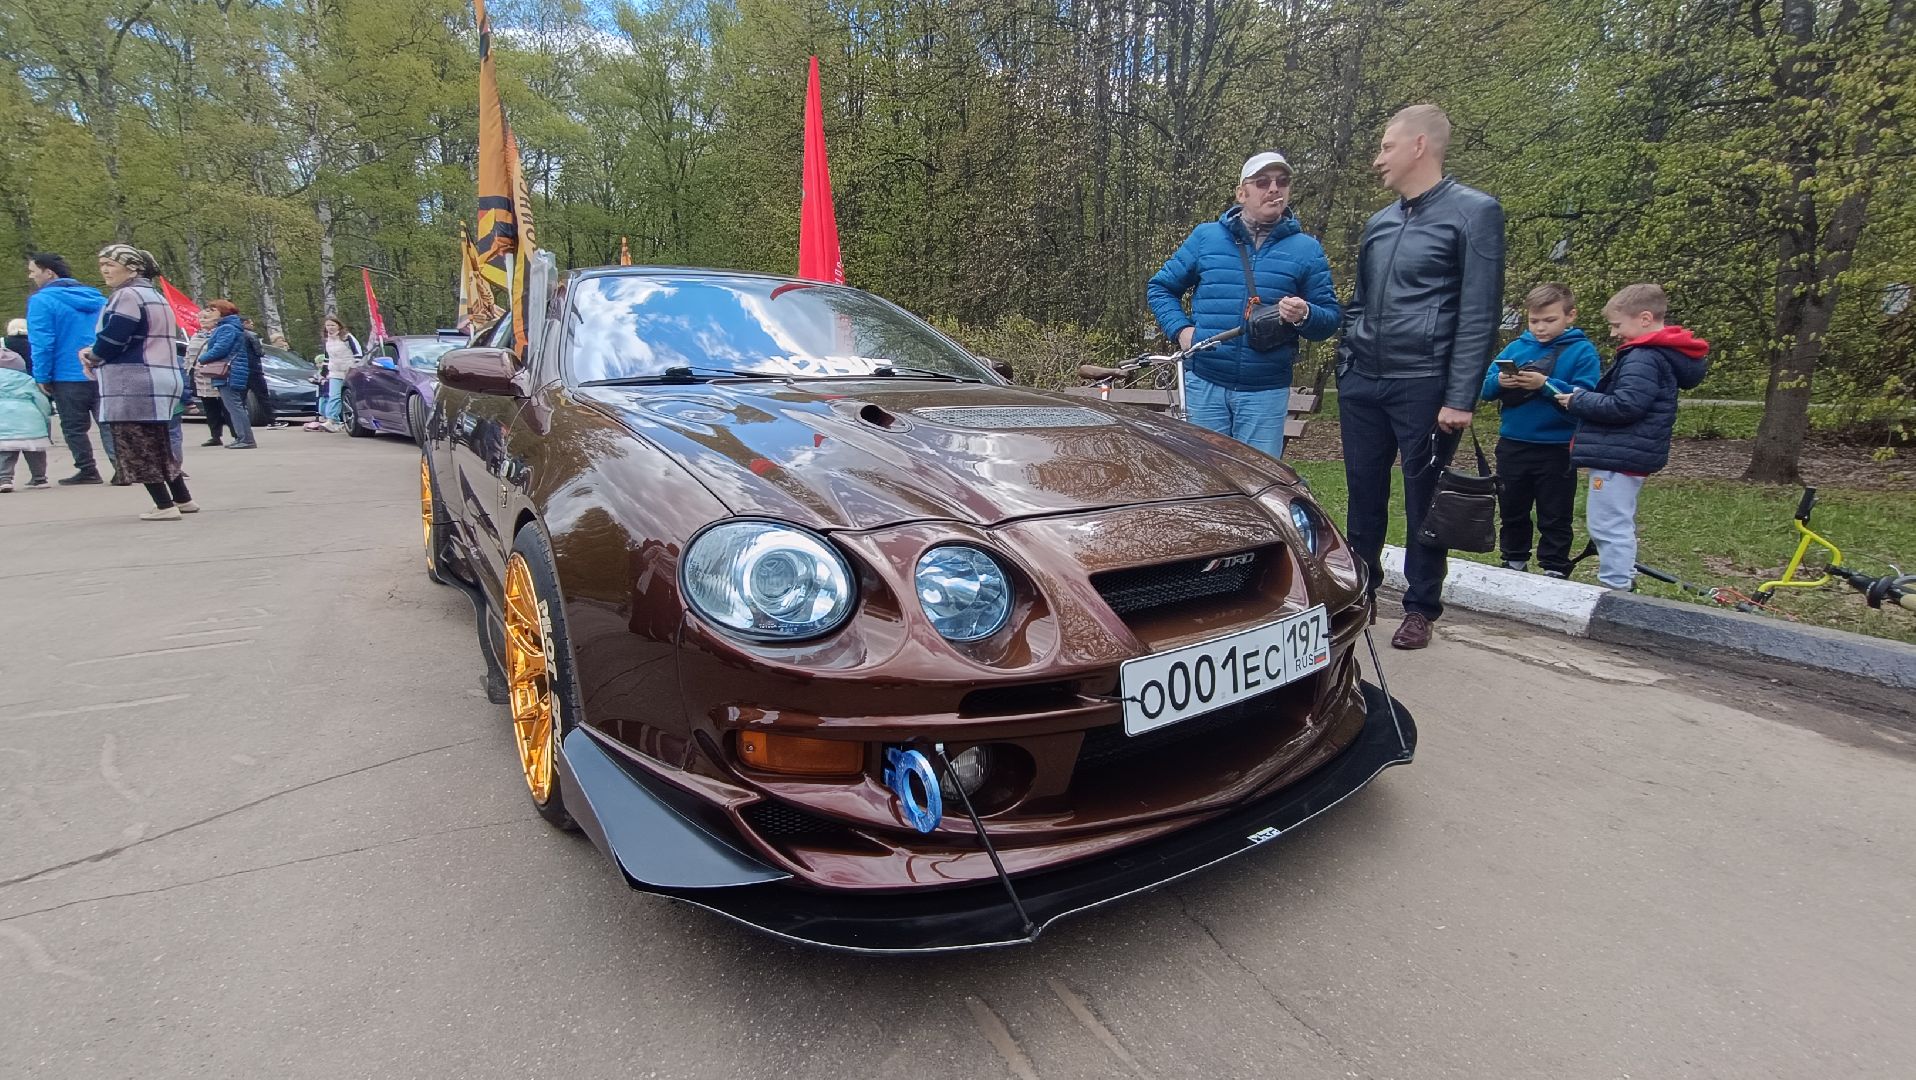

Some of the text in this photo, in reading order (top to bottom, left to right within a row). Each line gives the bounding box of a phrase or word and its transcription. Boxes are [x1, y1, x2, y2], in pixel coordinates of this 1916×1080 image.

[1219, 552, 1255, 568] TRD
[538, 599, 558, 681] PILOT
[1287, 614, 1320, 660] 197
[1295, 658, 1314, 672] RUS
